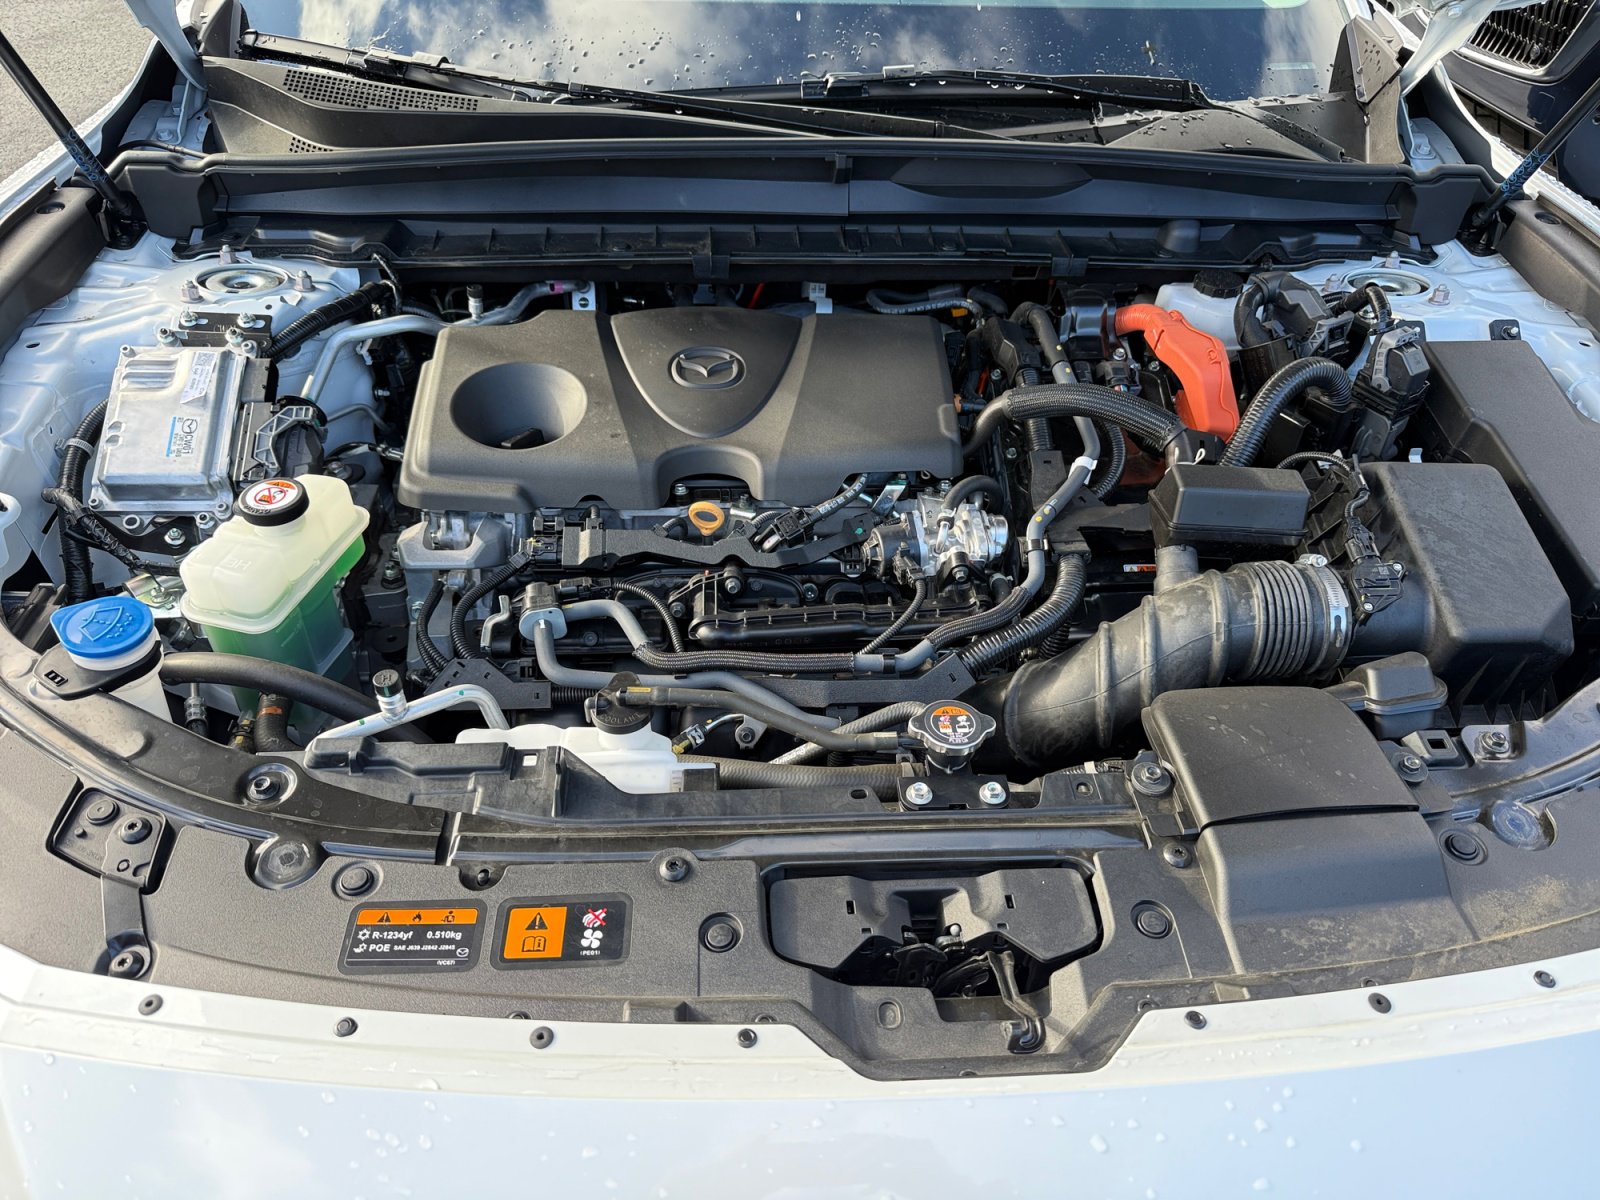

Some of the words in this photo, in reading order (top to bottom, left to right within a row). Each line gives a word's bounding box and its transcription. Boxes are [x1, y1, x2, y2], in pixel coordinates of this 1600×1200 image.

[600, 711, 641, 724] COOLANT
[371, 930, 414, 941] R-1234yf
[426, 930, 463, 940] 0.510kg
[368, 943, 391, 952] POE
